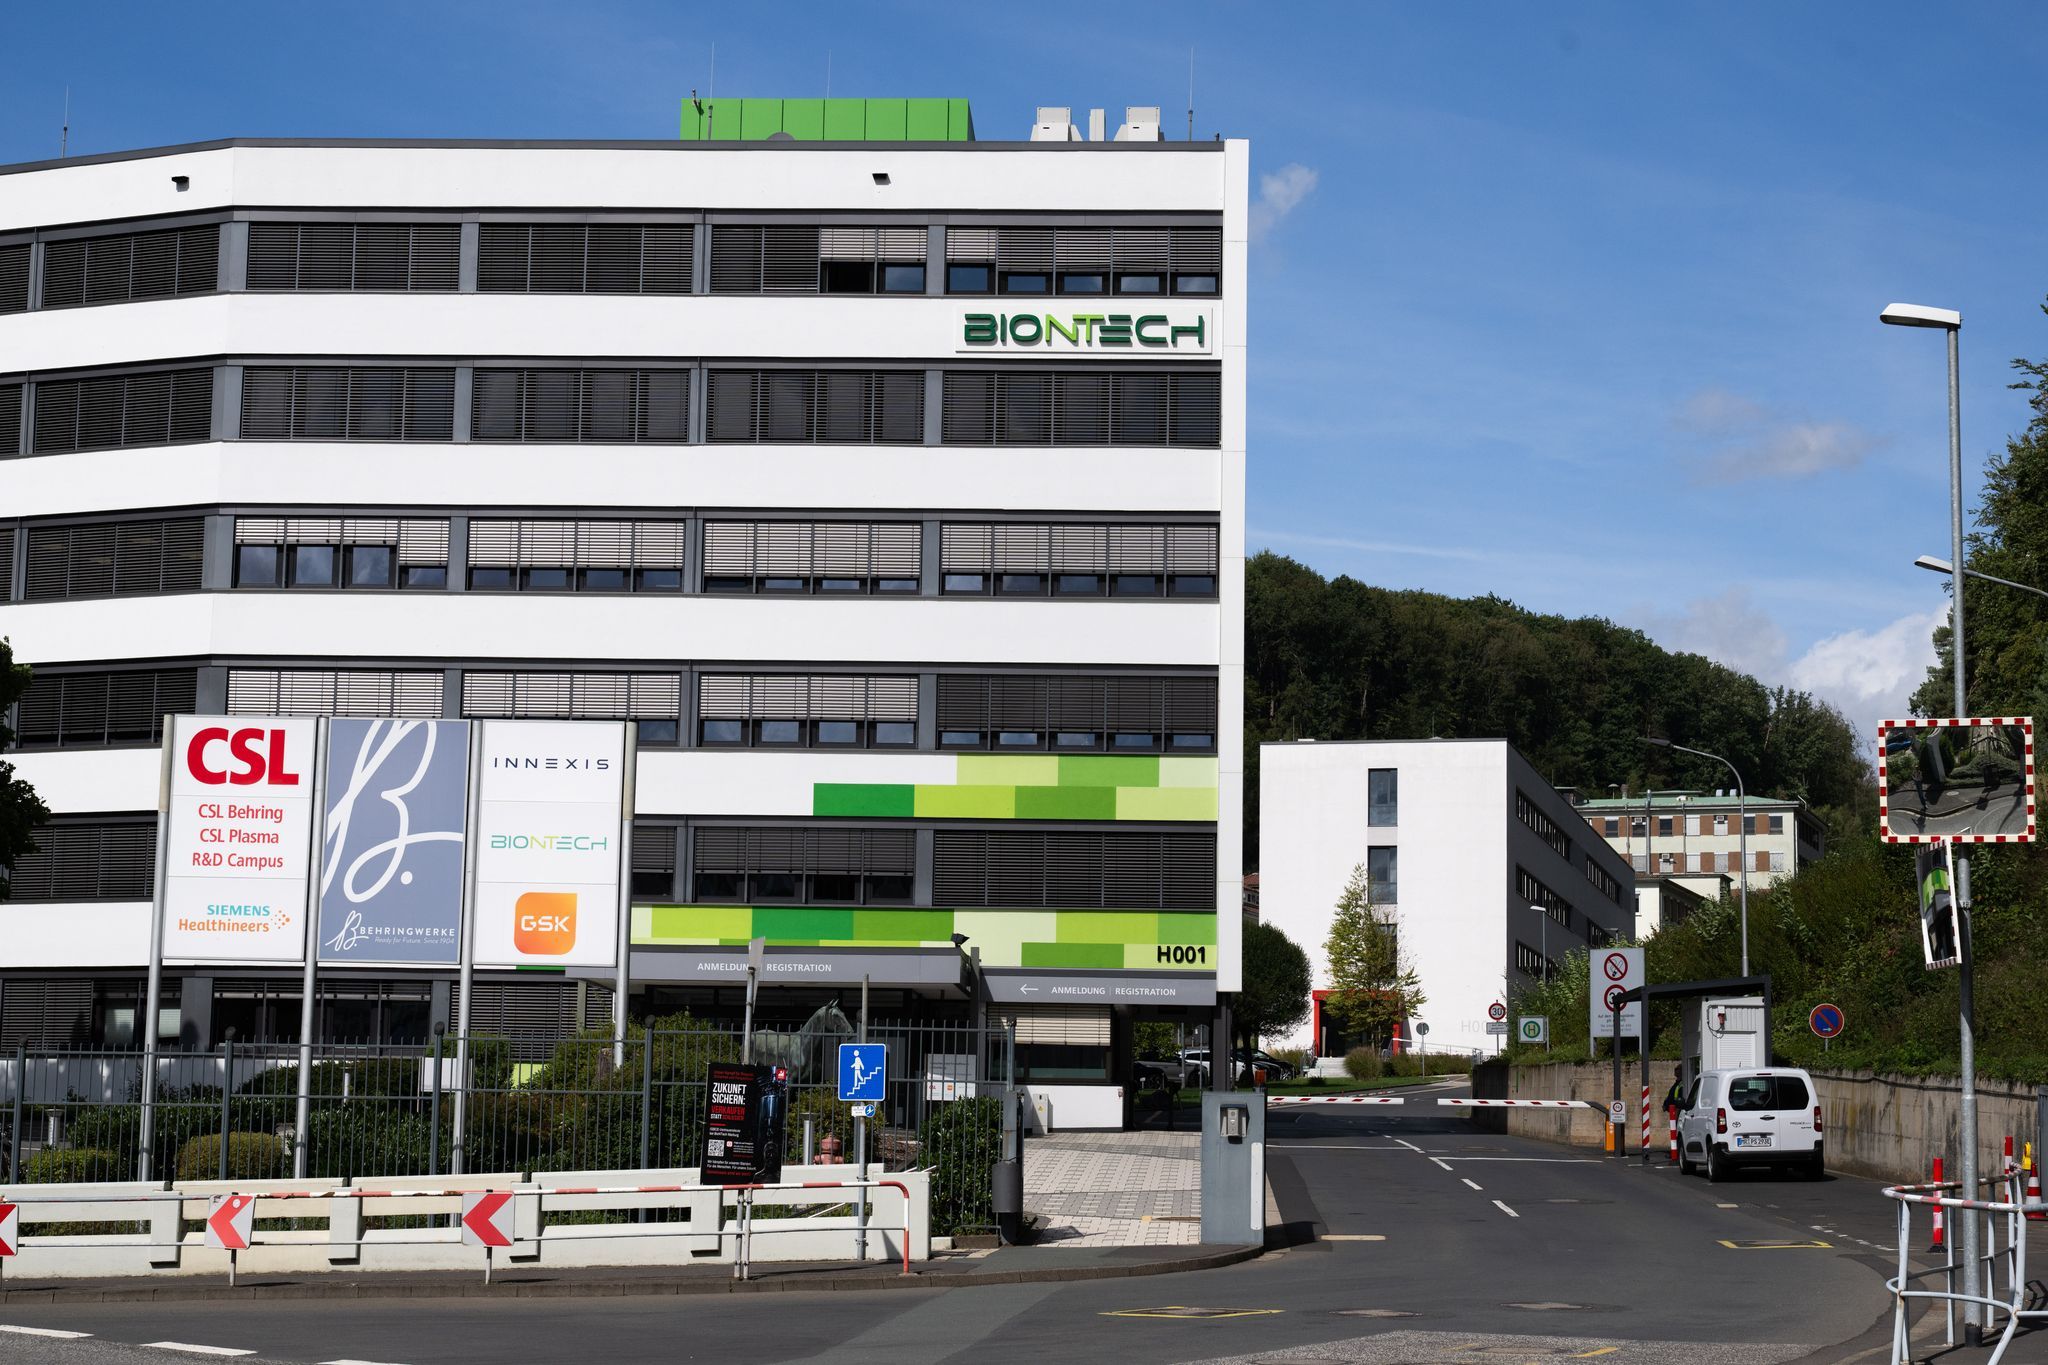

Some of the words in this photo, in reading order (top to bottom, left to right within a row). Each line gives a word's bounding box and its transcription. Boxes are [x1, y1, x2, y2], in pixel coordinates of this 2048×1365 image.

[964, 313, 1204, 346] BIONTECH
[187, 727, 299, 785] CSL
[494, 757, 609, 770] INNEXIS
[198, 803, 224, 819] CSL
[228, 804, 283, 824] Behring
[200, 828, 224, 843] CSL
[229, 829, 280, 844] Plasma
[491, 834, 608, 850] BIONTECH
[192, 852, 223, 867] R&D
[227, 853, 283, 871] Campus
[207, 904, 270, 917] SIEMENS
[178, 918, 270, 932] Healthineers
[521, 915, 570, 932] GSK
[360, 926, 455, 937] BEHRINGWERKE
[375, 936, 392, 944] Ready
[392, 937, 401, 945] for
[1157, 945, 1206, 964] H001
[697, 963, 749, 971] ANMELDUN
[766, 963, 832, 972] REGISTRATION
[1051, 986, 1106, 995] ANMELDUNG
[1115, 987, 1176, 996] REGISTRATION
[1492, 1007, 1503, 1016] 30
[1528, 1025, 1536, 1035] H
[712, 1082, 747, 1095] ZUKUNFT
[711, 1093, 746, 1105] SICHERN:
